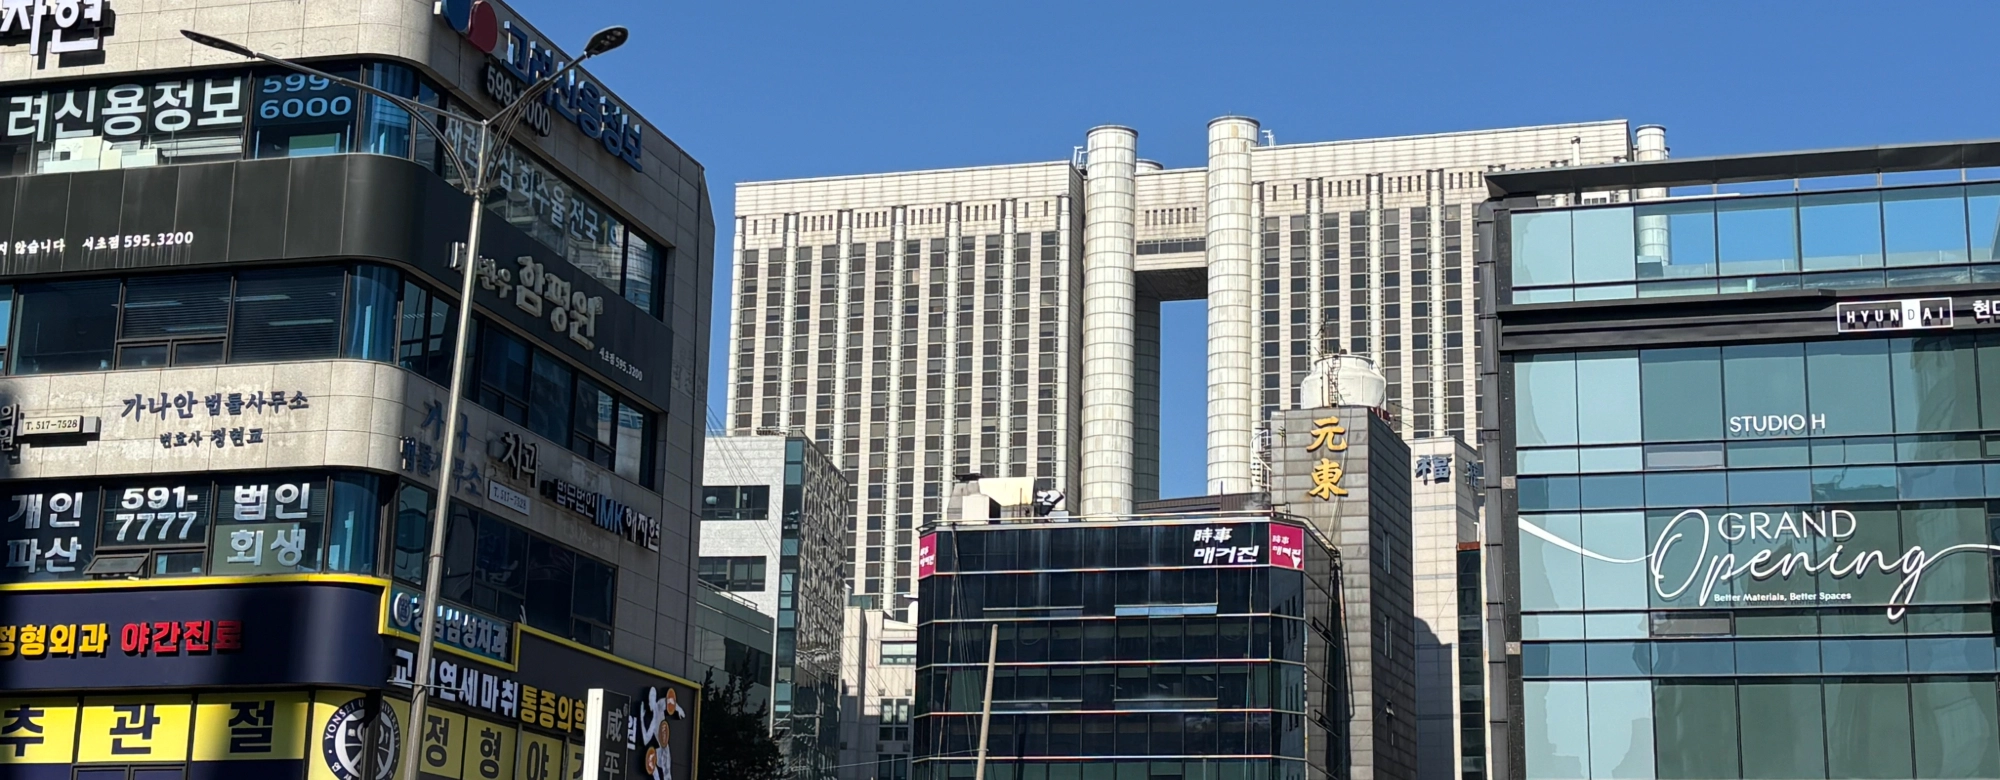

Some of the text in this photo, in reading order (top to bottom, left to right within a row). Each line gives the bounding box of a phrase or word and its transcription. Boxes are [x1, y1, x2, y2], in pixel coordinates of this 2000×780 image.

[6, 76, 244, 143] 려신용정보
[259, 96, 352, 120] 6000
[503, 21, 643, 173] 고려신용정보
[82, 235, 120, 251] 서초점
[123, 230, 194, 249] 595.3200
[569, 196, 599, 251] 전국
[515, 255, 597, 350] 함평원
[1846, 306, 1944, 324] HYUNDAI
[35, 419, 78, 430] 517-7528
[121, 390, 310, 423] 가나안 법률사무소
[1729, 413, 1826, 433] STUDIO H
[159, 429, 203, 449] 변호사
[1306, 415, 1348, 500] 元東
[501, 432, 541, 488] 치과
[8, 491, 84, 530] 개인
[121, 486, 199, 510] 591-
[234, 483, 311, 521] 법인
[557, 479, 594, 518] 법무법인
[595, 493, 624, 537] IMK
[115, 511, 198, 542] 7777
[1717, 509, 1857, 542] GRAND
[6, 536, 82, 573] 파산
[227, 528, 306, 567] 회생
[1193, 545, 1260, 564] 매거진
[1650, 508, 1930, 621] Opening
[1713, 591, 1852, 602] Better Materials, Better Spaces
[121, 619, 242, 652] 야간진료
[1, 700, 275, 757] 추 관 절
[324, 701, 357, 741] YONSEI
[425, 715, 449, 768] 정
[480, 727, 502, 779] 형
